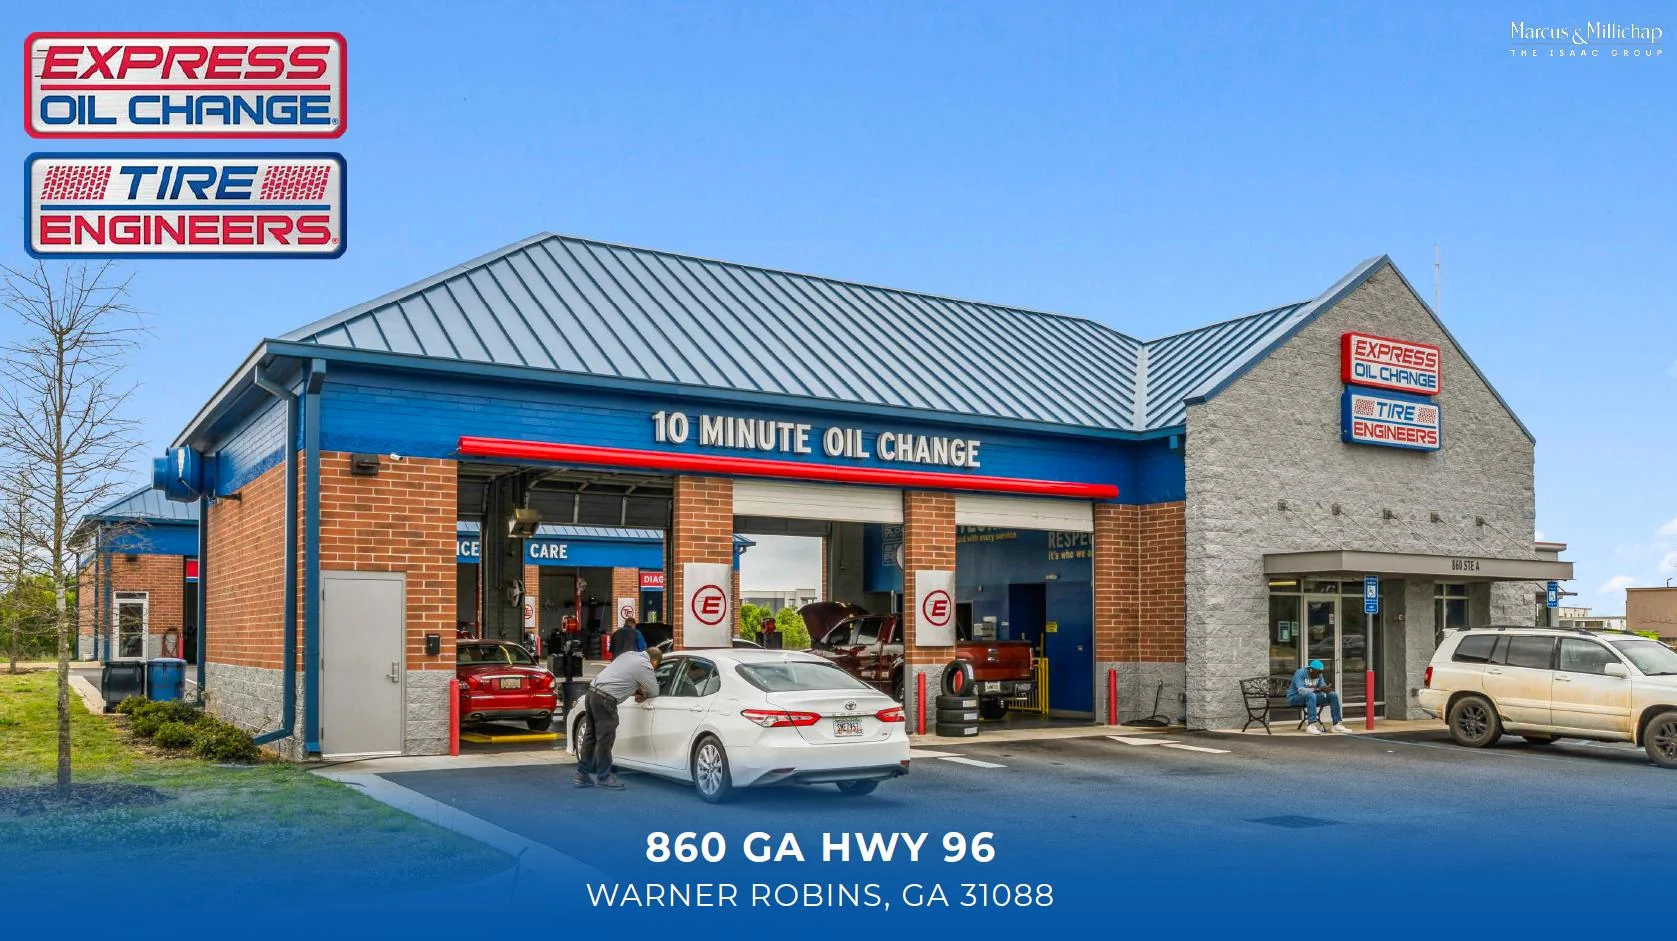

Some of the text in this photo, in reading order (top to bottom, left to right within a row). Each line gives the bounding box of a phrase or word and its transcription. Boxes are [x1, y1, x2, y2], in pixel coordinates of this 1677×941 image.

[1354, 339, 1437, 368] EXPRESS
[1354, 362, 1437, 389] OIL CHANGE
[1376, 401, 1416, 422] TIRE
[652, 410, 981, 468] 10 MINUTE OIL CHANGE
[1353, 421, 1438, 445] ENGINEERS
[529, 543, 568, 560] CARE
[1451, 559, 1480, 571] 860 STE A
[700, 596, 722, 615] E
[930, 599, 948, 617] E
